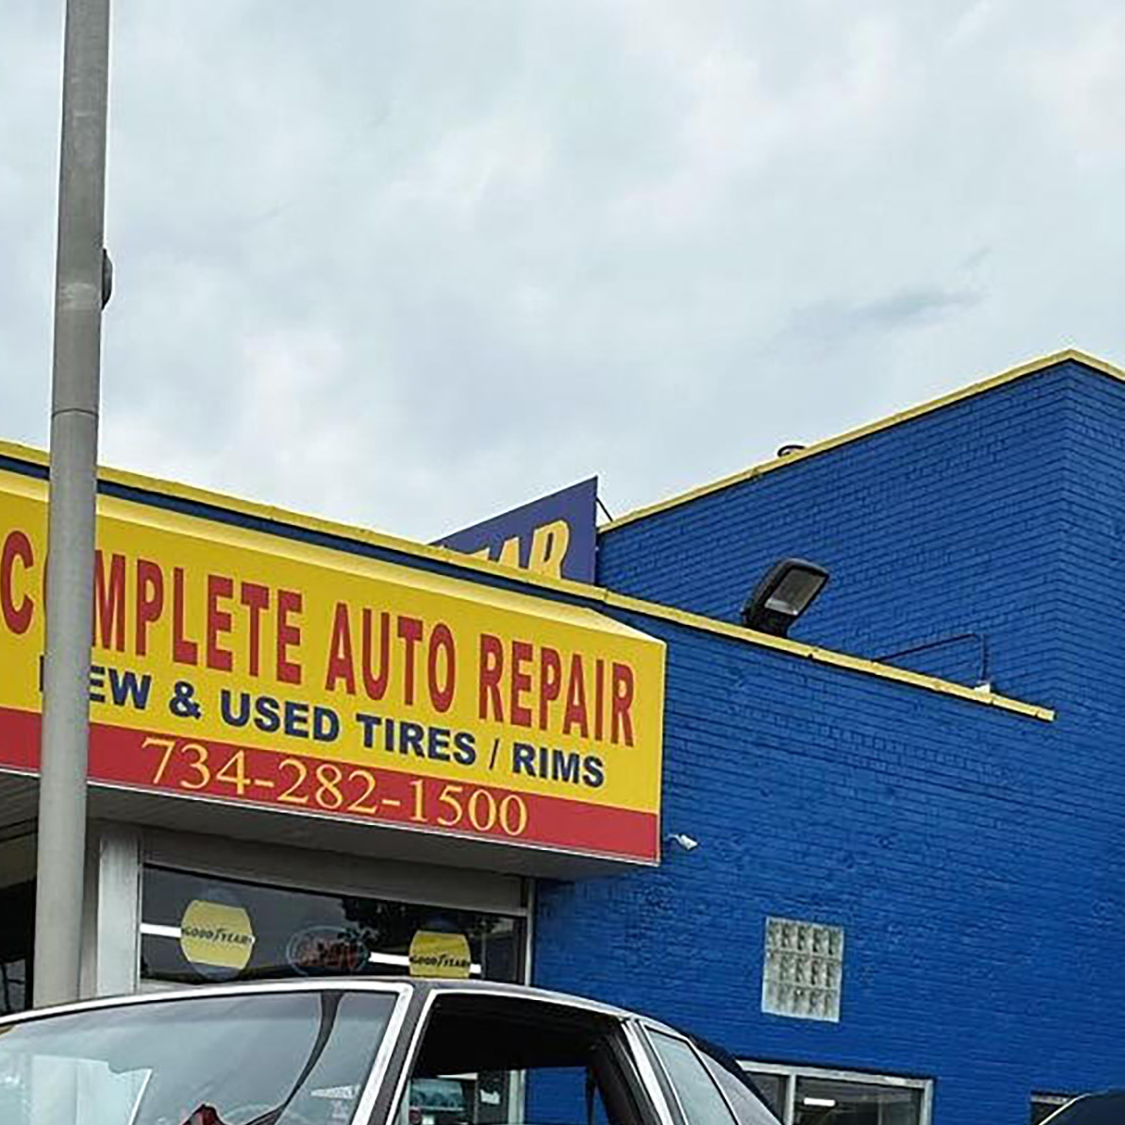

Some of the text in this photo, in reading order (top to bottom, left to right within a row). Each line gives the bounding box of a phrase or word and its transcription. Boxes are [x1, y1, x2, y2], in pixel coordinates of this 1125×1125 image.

[0, 530, 635, 747] CMPLETE AUTO REPAIR
[39, 655, 152, 710] EW
[169, 680, 202, 720] &
[220, 689, 340, 742] USED
[356, 712, 476, 765] TIRES
[512, 742, 605, 788] RIMS
[140, 735, 529, 837] 734-282-1500
